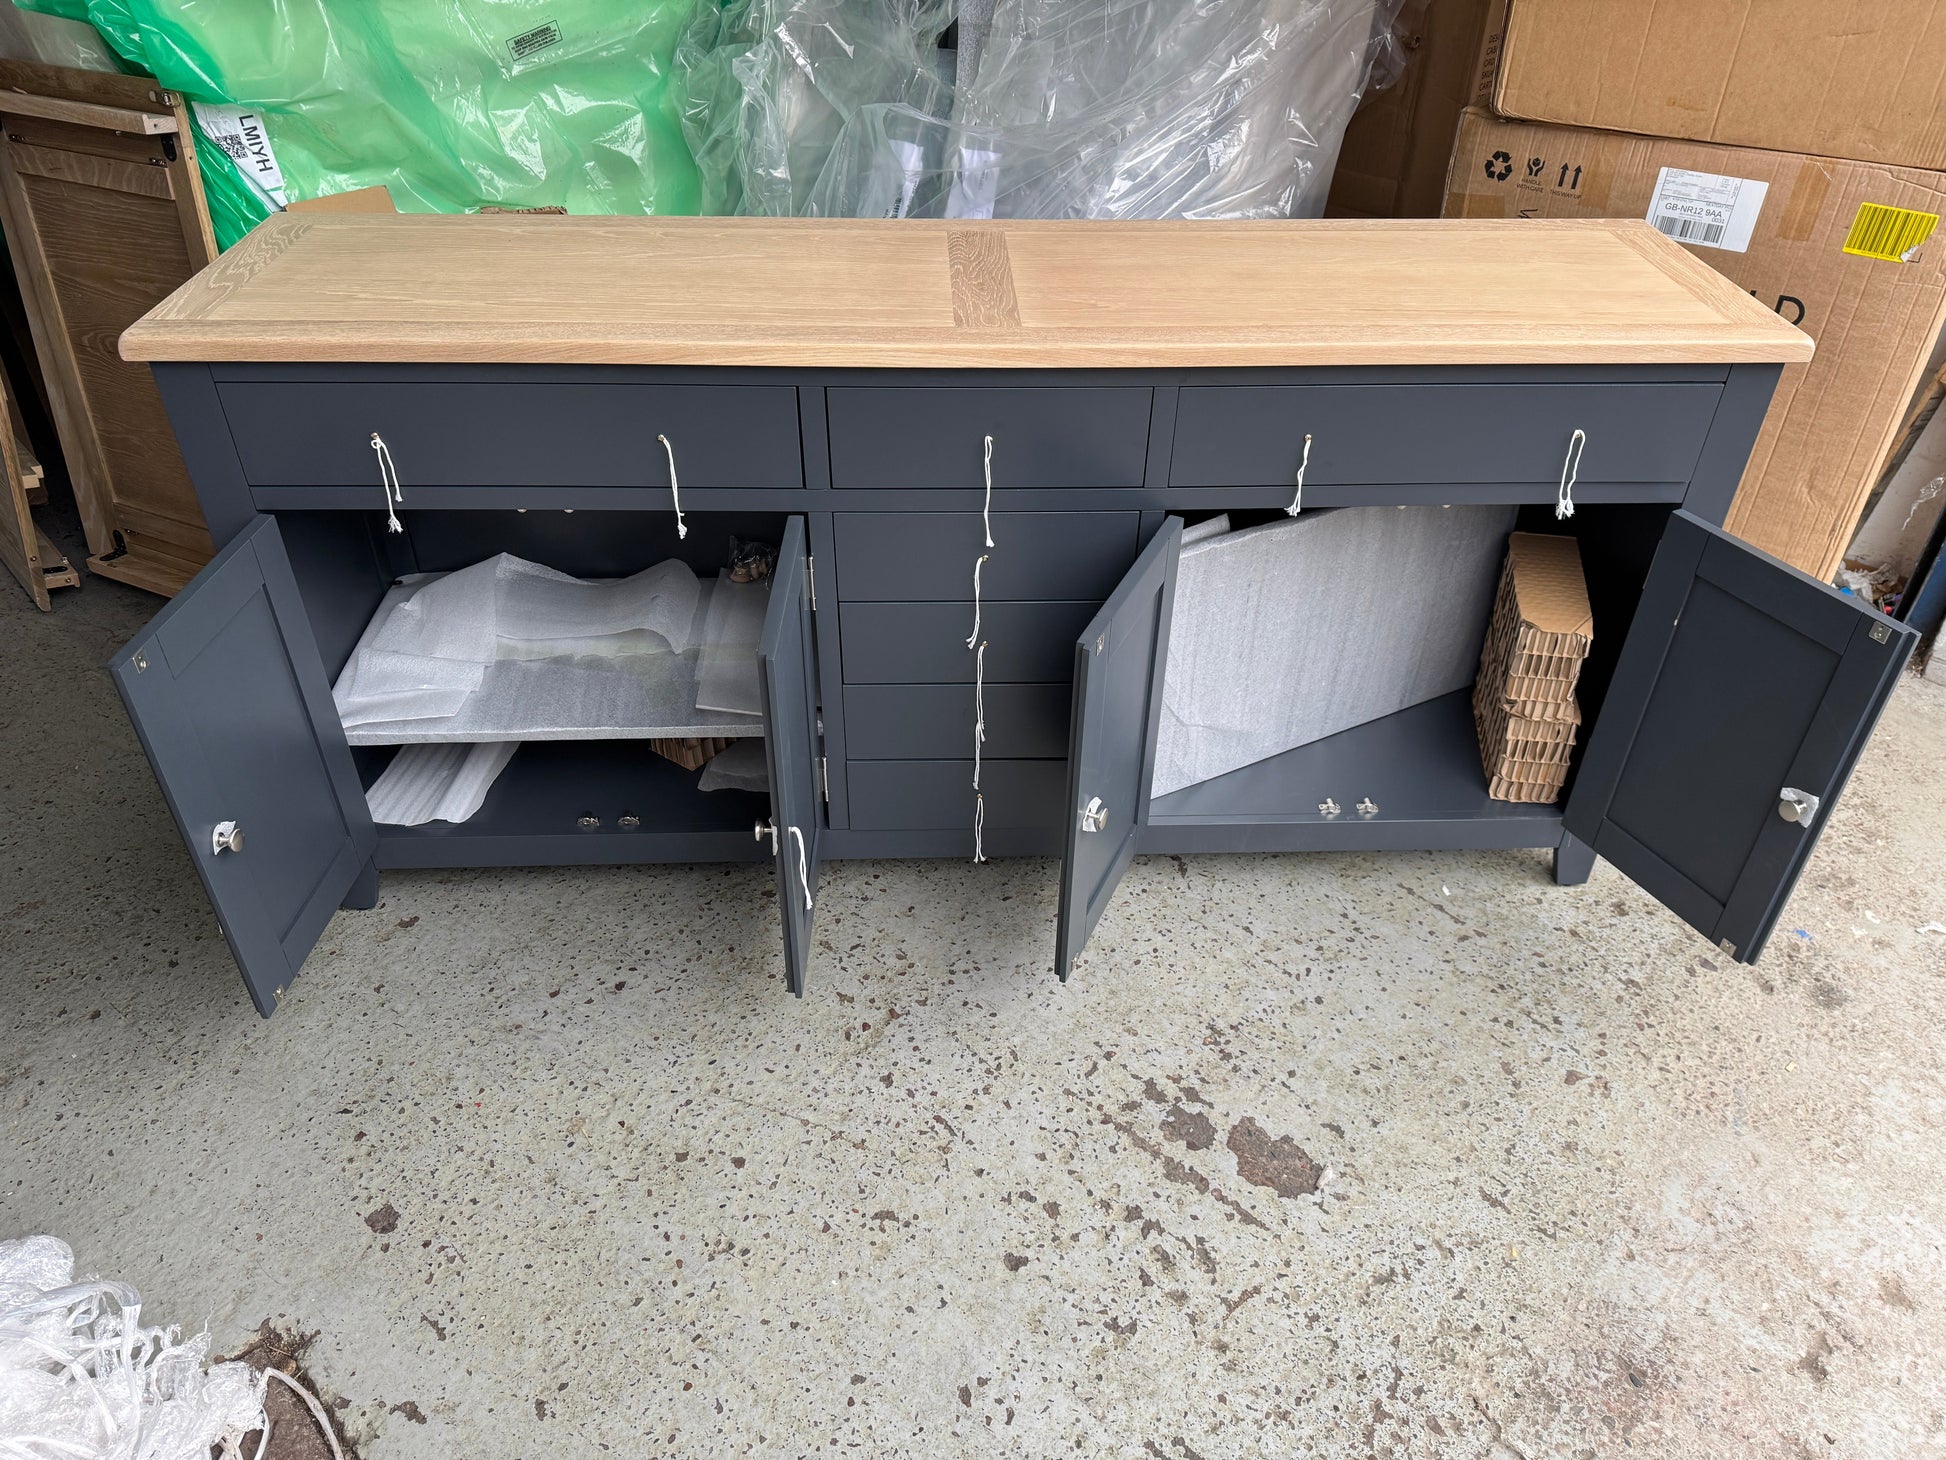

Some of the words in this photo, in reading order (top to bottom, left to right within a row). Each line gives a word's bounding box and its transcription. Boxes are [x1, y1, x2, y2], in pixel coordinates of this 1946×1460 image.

[239, 114, 273, 172] LMIYH
[1521, 178, 1541, 186] HANDLE
[1561, 191, 1574, 199] WAY
[1665, 202, 1704, 215] GB-NR12
[1705, 208, 1722, 218] 9AA
